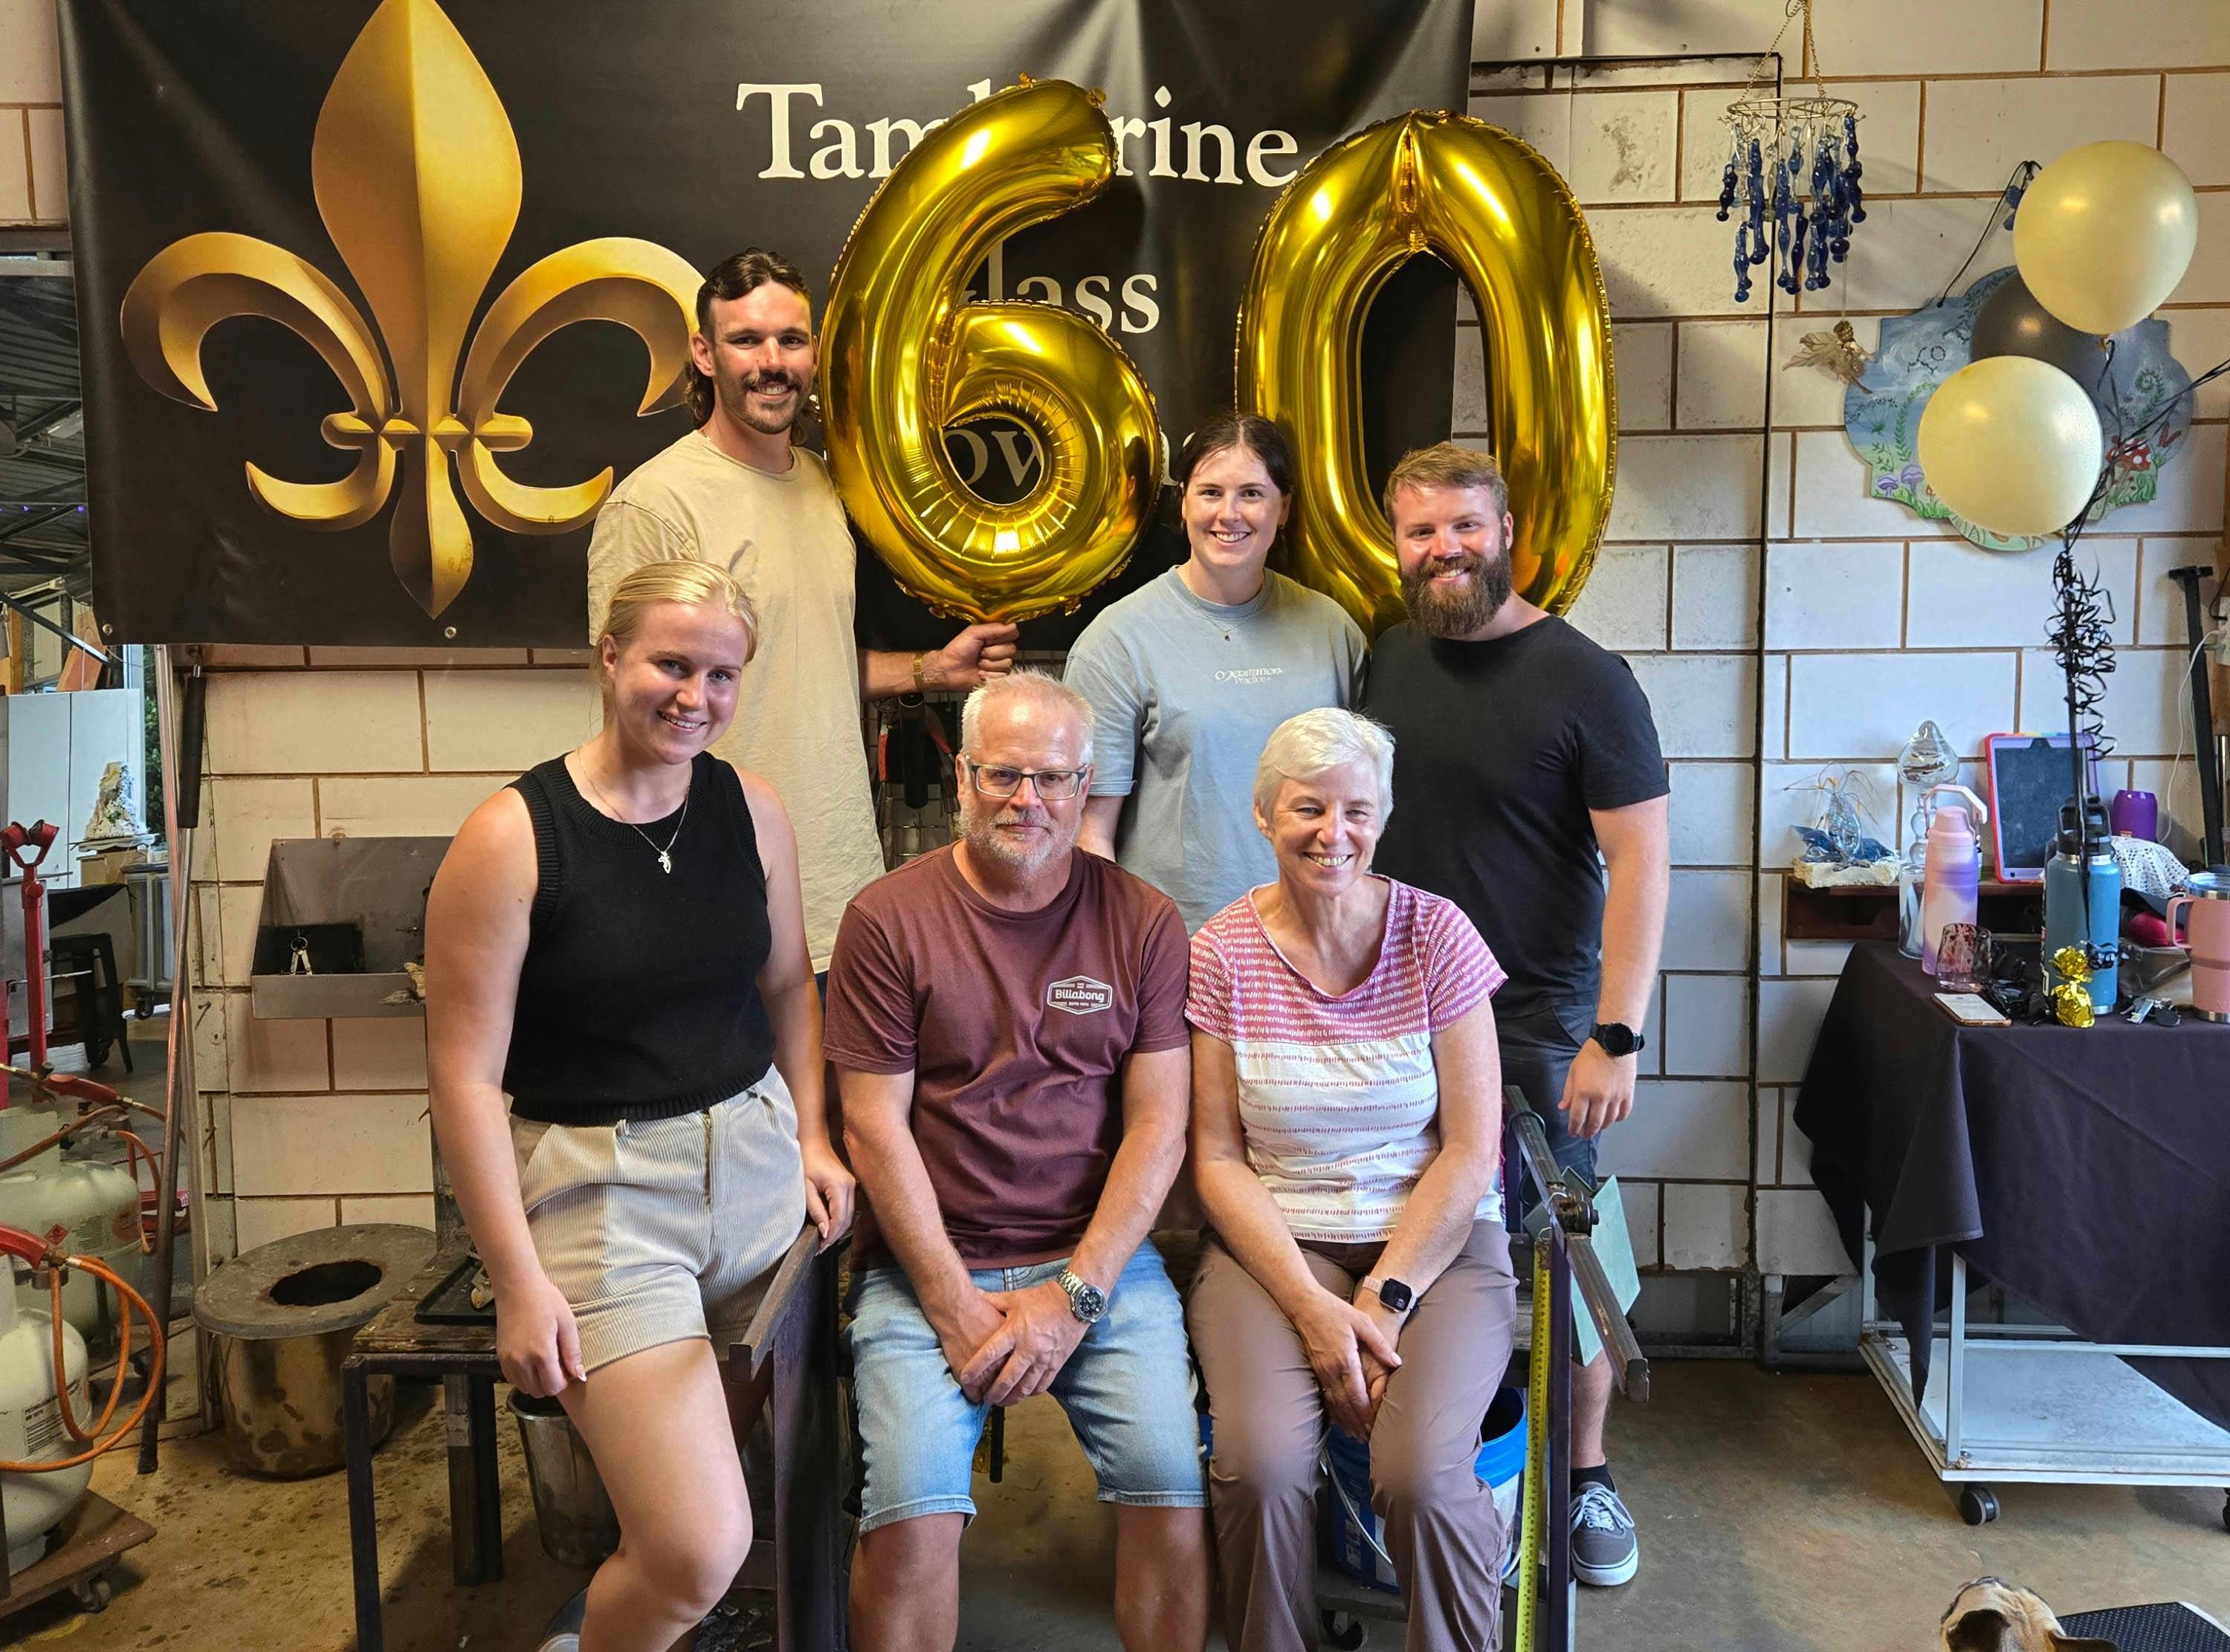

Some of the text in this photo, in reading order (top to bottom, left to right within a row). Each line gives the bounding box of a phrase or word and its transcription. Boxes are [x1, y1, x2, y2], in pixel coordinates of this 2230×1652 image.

[736, 78, 1299, 187] Tamrine
[959, 240, 1160, 334] lass
[1055, 988, 1105, 1003] Billabong
